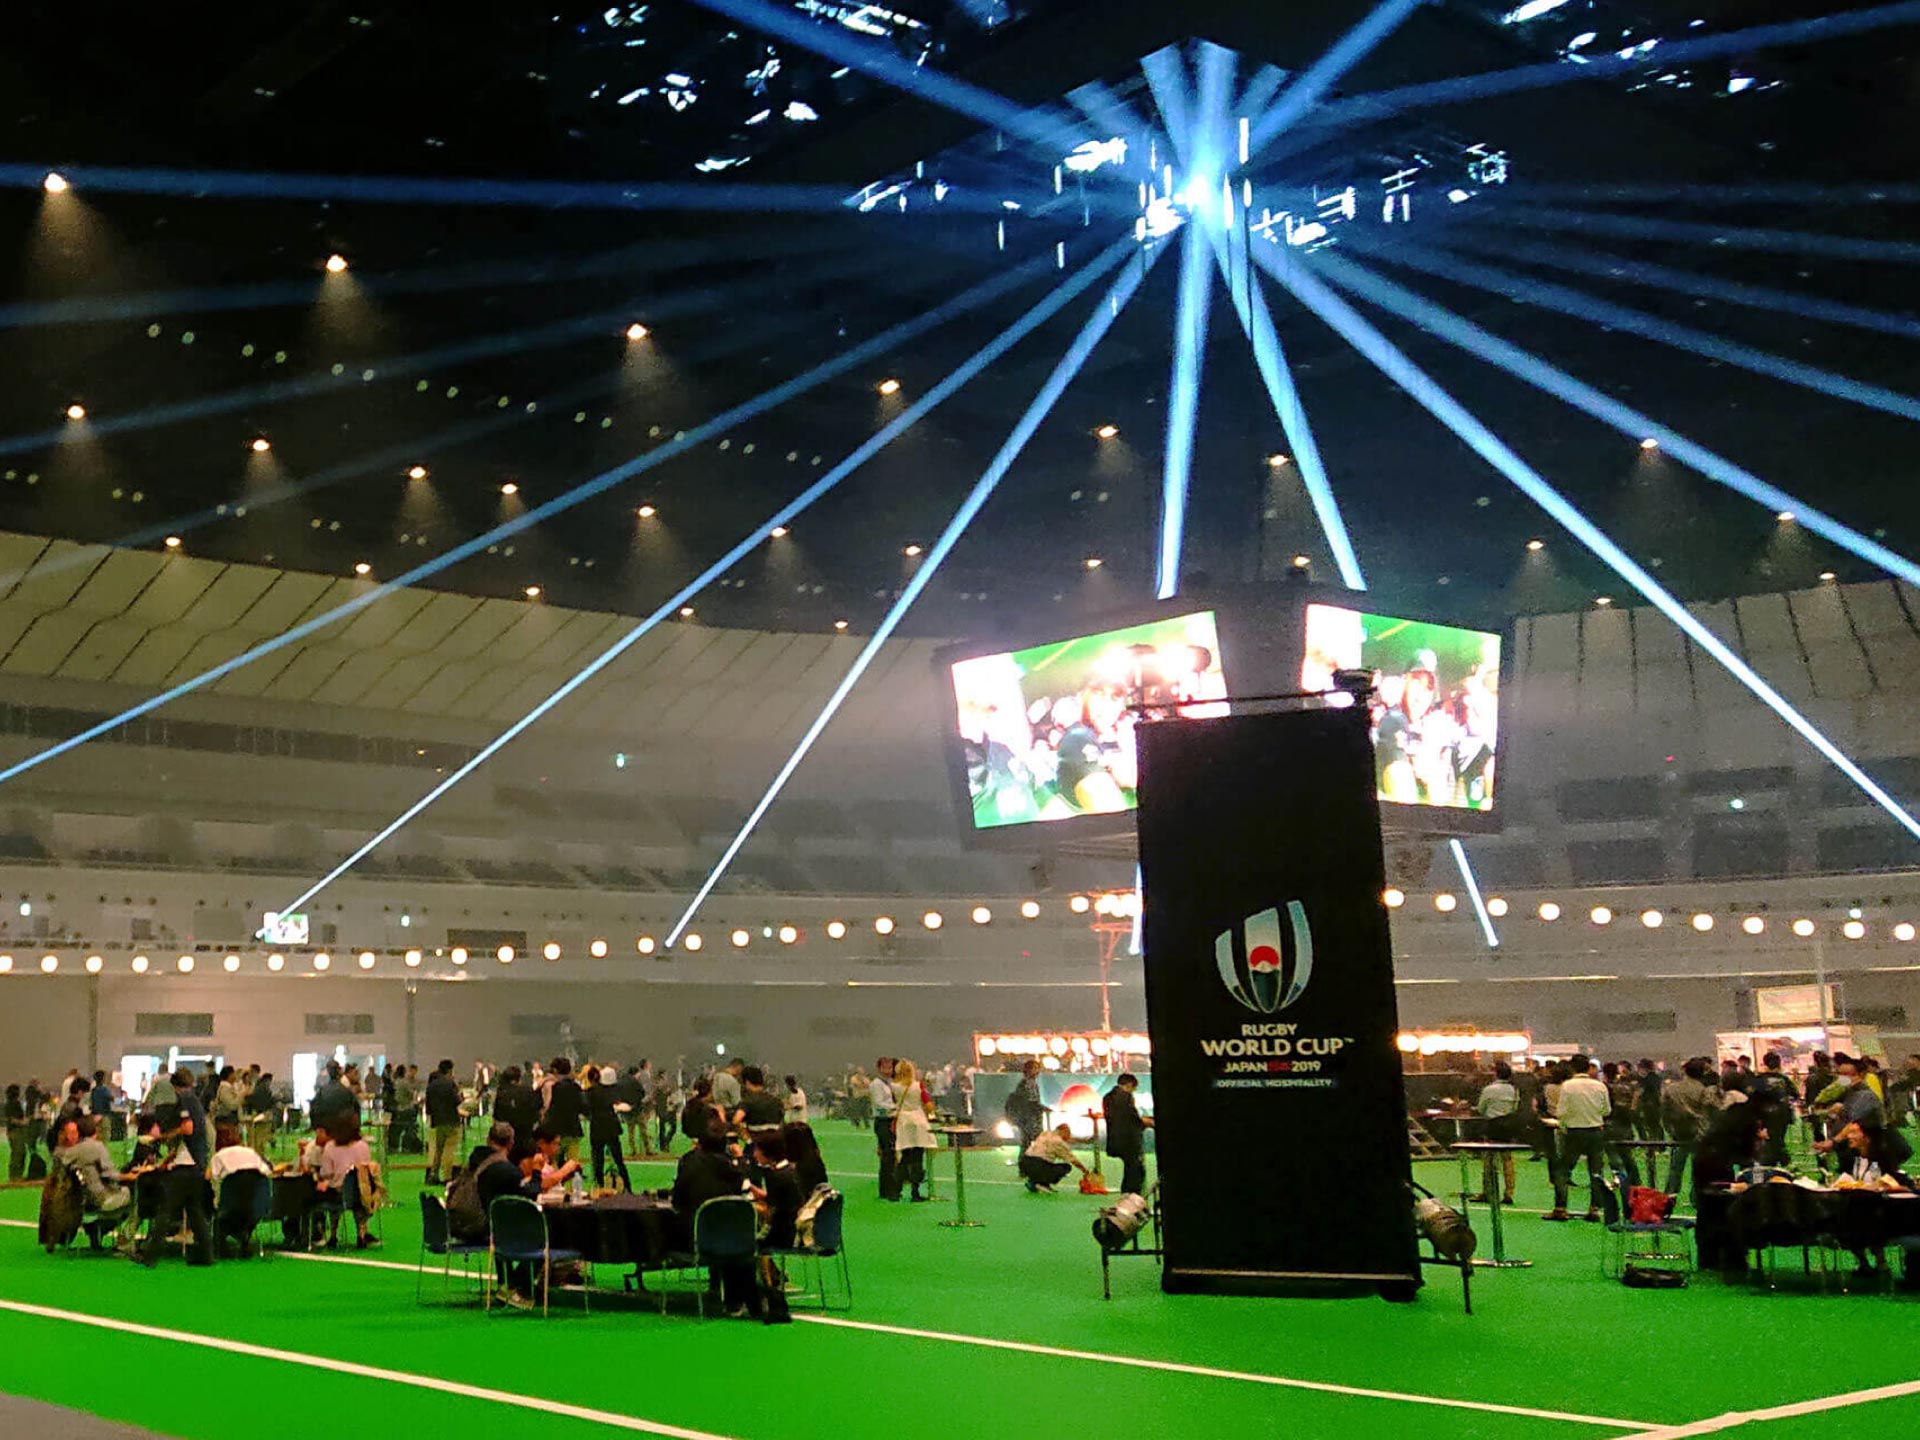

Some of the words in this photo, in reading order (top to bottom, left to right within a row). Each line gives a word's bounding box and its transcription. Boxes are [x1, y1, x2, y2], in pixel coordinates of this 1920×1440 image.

[1241, 1023, 1298, 1037] RUGBY
[1200, 1039, 1291, 1056] WORLD
[1223, 1061, 1268, 1073] JAPAN
[1291, 1060, 1321, 1072] 2019
